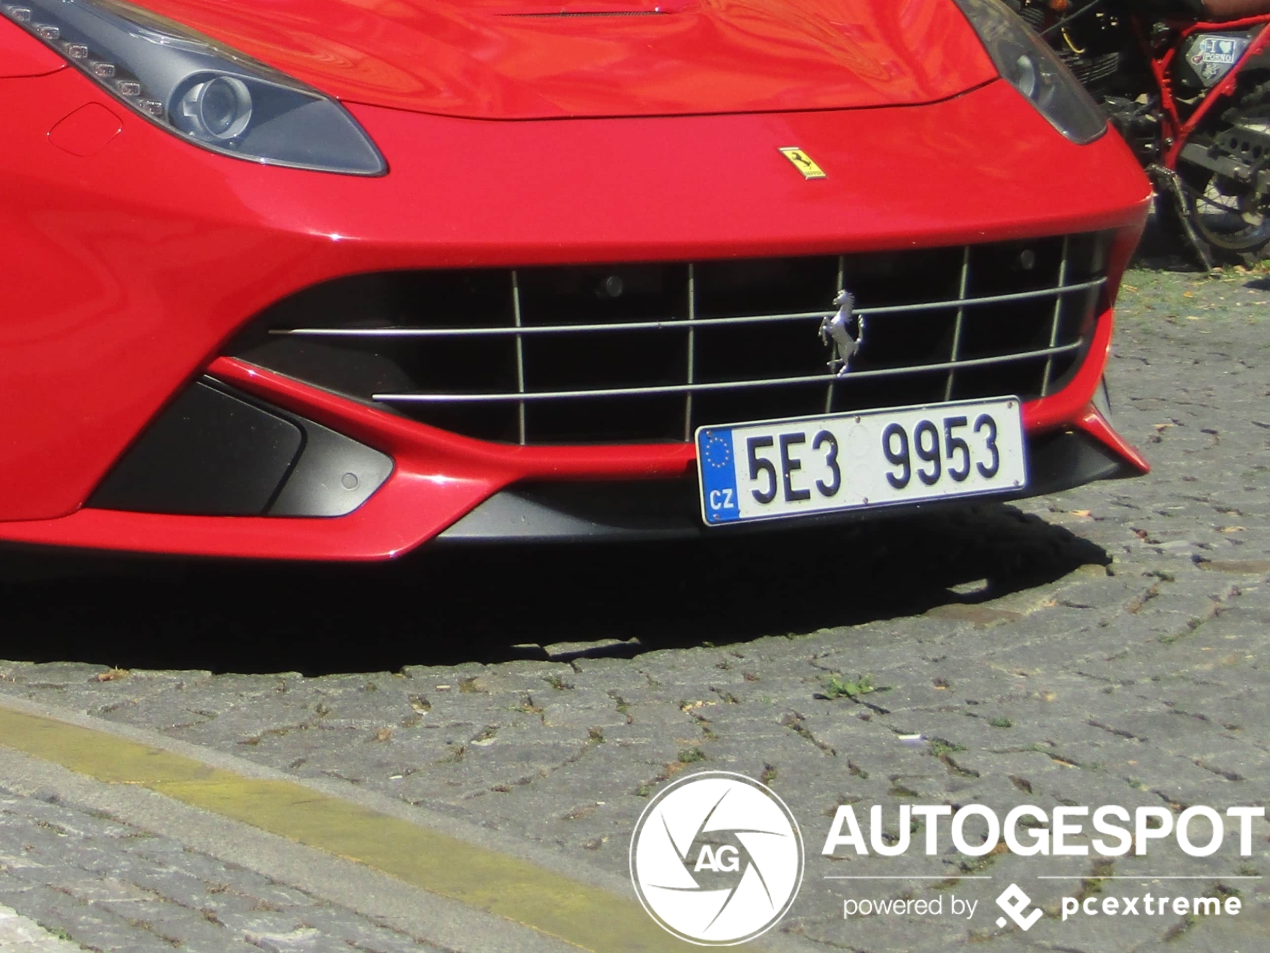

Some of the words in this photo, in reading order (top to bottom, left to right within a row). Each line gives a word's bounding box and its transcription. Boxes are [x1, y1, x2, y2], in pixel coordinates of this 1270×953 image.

[746, 430, 842, 504] 5E3
[882, 413, 1000, 489] 9953
[710, 489, 734, 510] CZ
